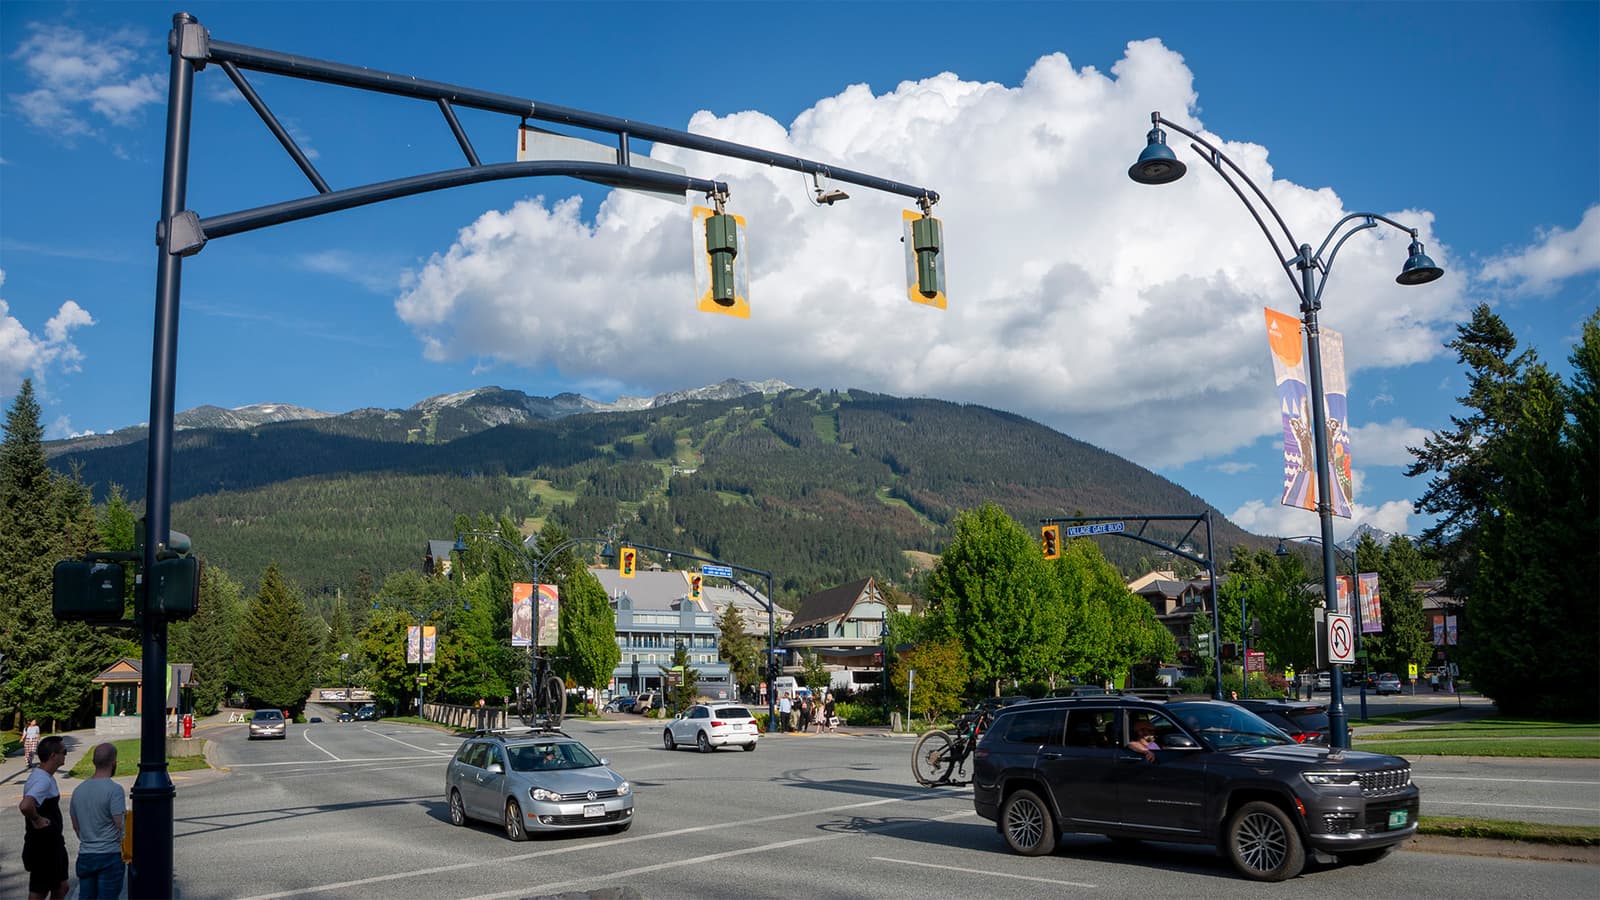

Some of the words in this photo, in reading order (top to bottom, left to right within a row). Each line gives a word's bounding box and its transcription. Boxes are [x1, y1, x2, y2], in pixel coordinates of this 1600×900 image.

[1070, 526, 1090, 535] VILLAGE
[1092, 524, 1106, 533] GATE
[1108, 523, 1122, 531] BLVD
